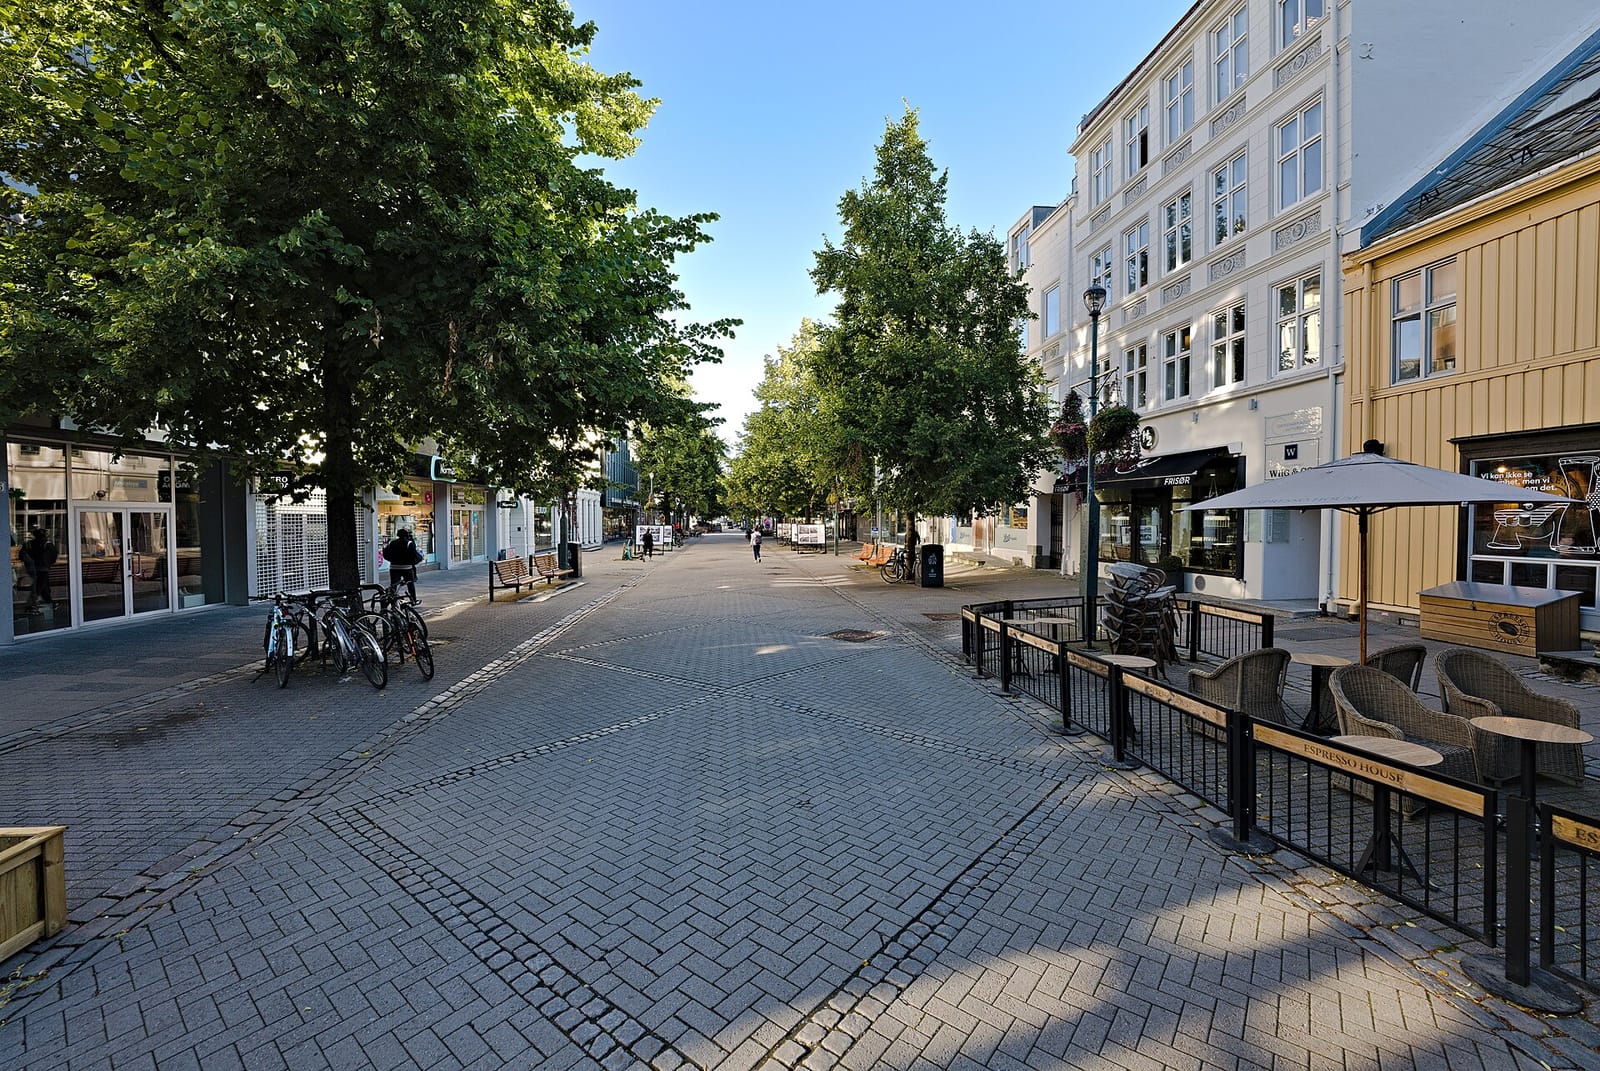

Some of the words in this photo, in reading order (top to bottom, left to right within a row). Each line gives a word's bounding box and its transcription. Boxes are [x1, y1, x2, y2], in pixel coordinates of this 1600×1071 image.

[1164, 477, 1191, 486] FRISØR
[1303, 744, 1357, 768] ESPRESSO
[1360, 761, 1404, 784] HOUSE
